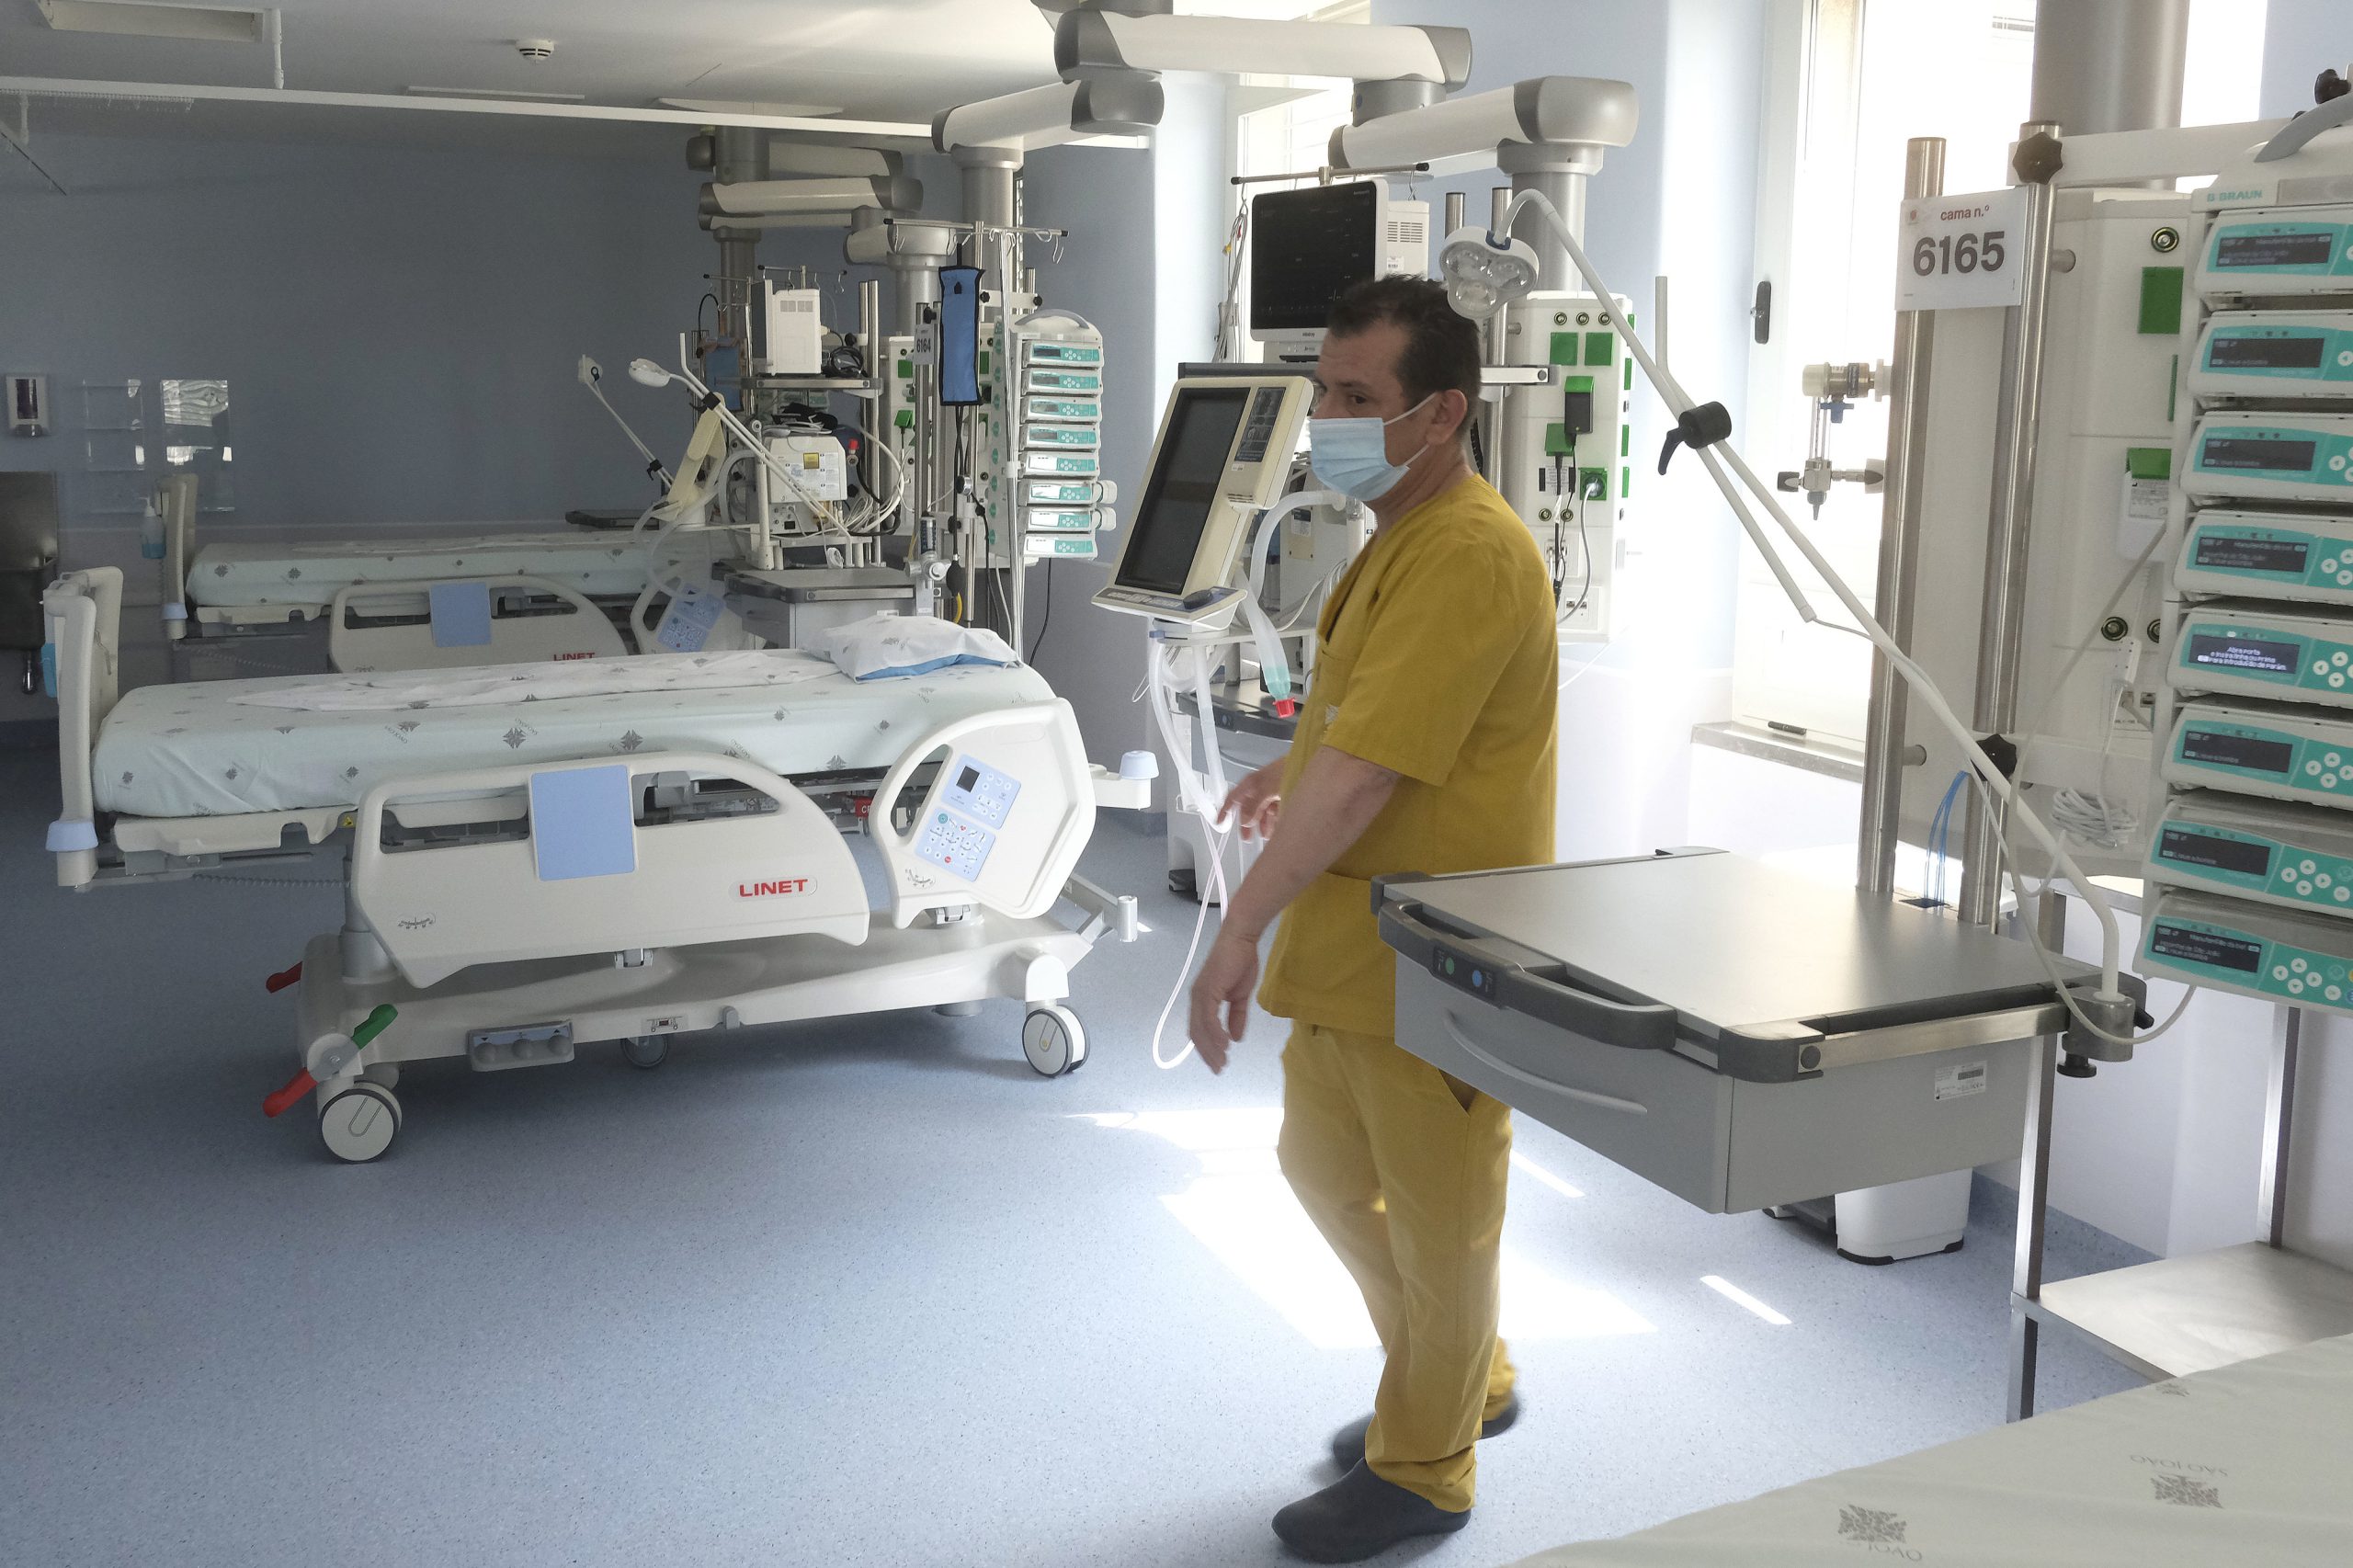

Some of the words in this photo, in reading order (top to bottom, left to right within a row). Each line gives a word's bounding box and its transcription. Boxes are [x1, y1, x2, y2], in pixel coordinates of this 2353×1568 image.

[2207, 192, 2215, 202] B
[2219, 189, 2263, 201] BRAUN
[1940, 209, 1972, 221] cama
[1913, 231, 2006, 277] 6165
[553, 653, 596, 662] LINET
[739, 879, 809, 897] LINET
